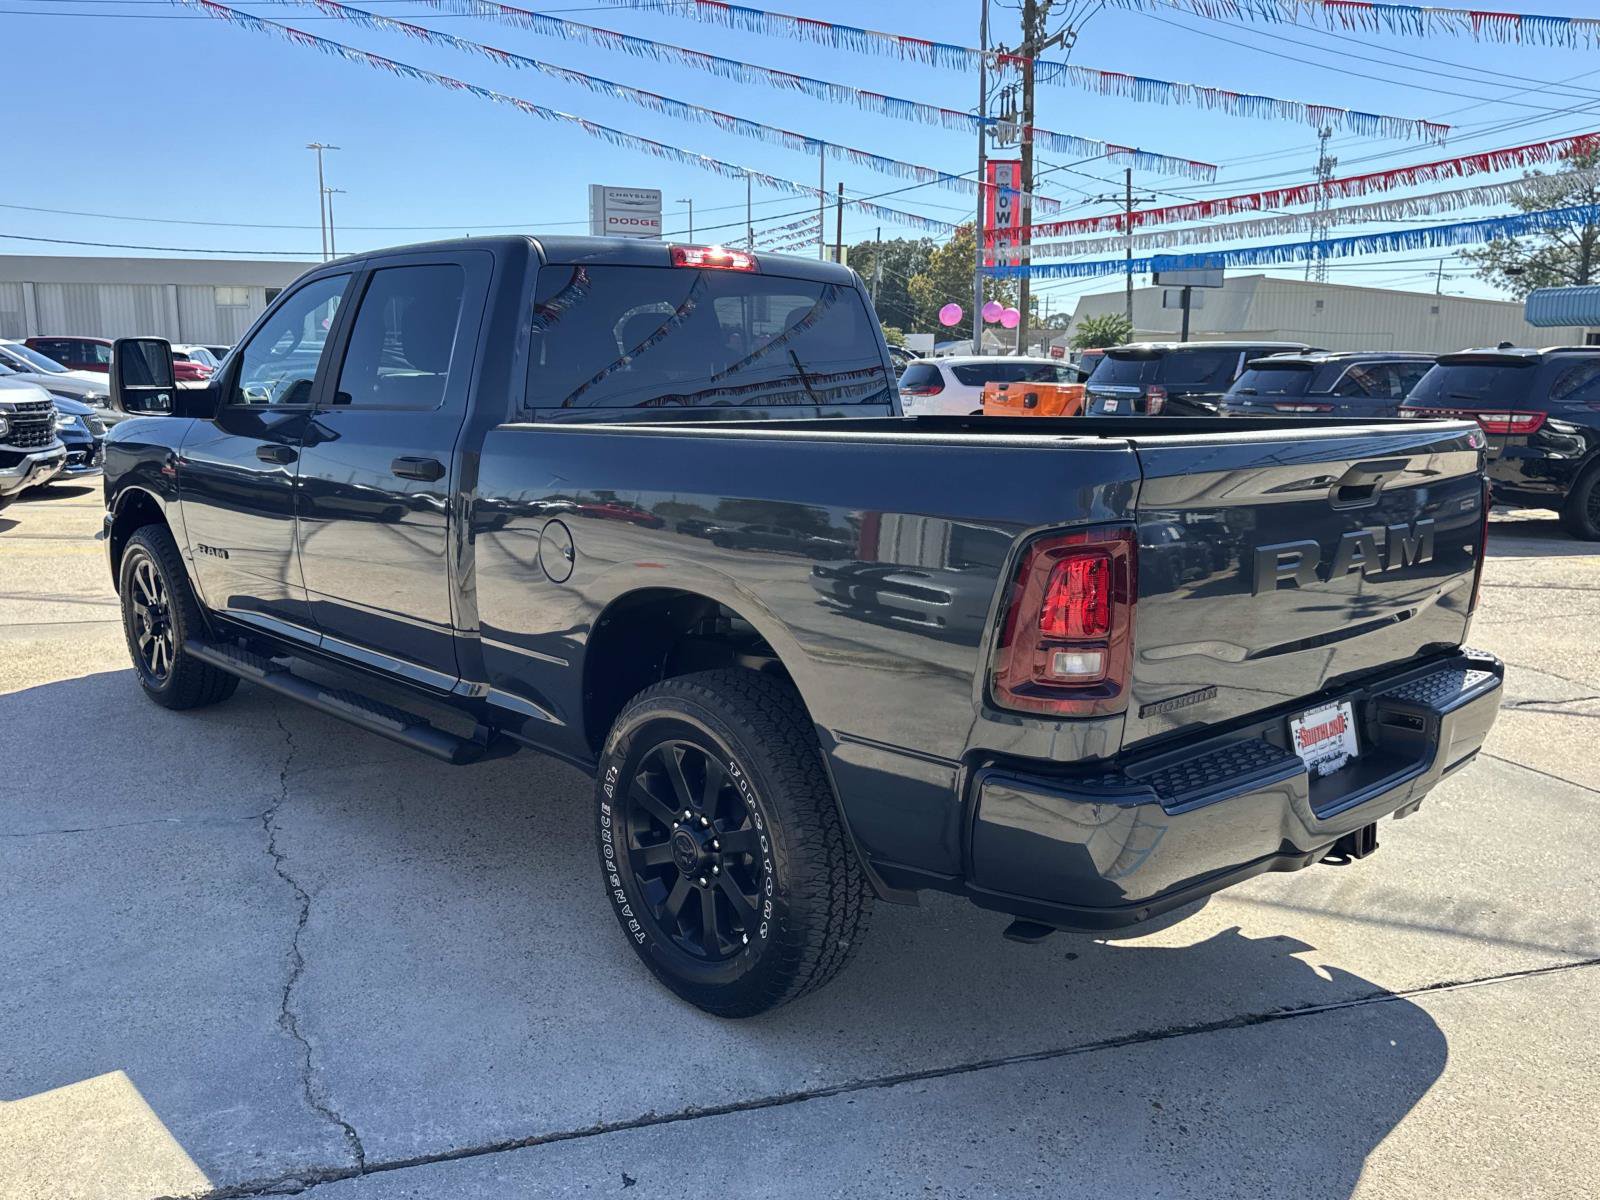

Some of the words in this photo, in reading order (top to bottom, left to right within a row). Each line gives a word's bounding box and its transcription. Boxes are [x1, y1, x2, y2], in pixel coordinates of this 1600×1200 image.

[608, 192, 658, 200] CHRYSLER
[608, 217, 659, 227] DODGE
[197, 543, 230, 560] RAM
[1252, 518, 1435, 597] RAM
[600, 802, 647, 945] TRANSFORCE
